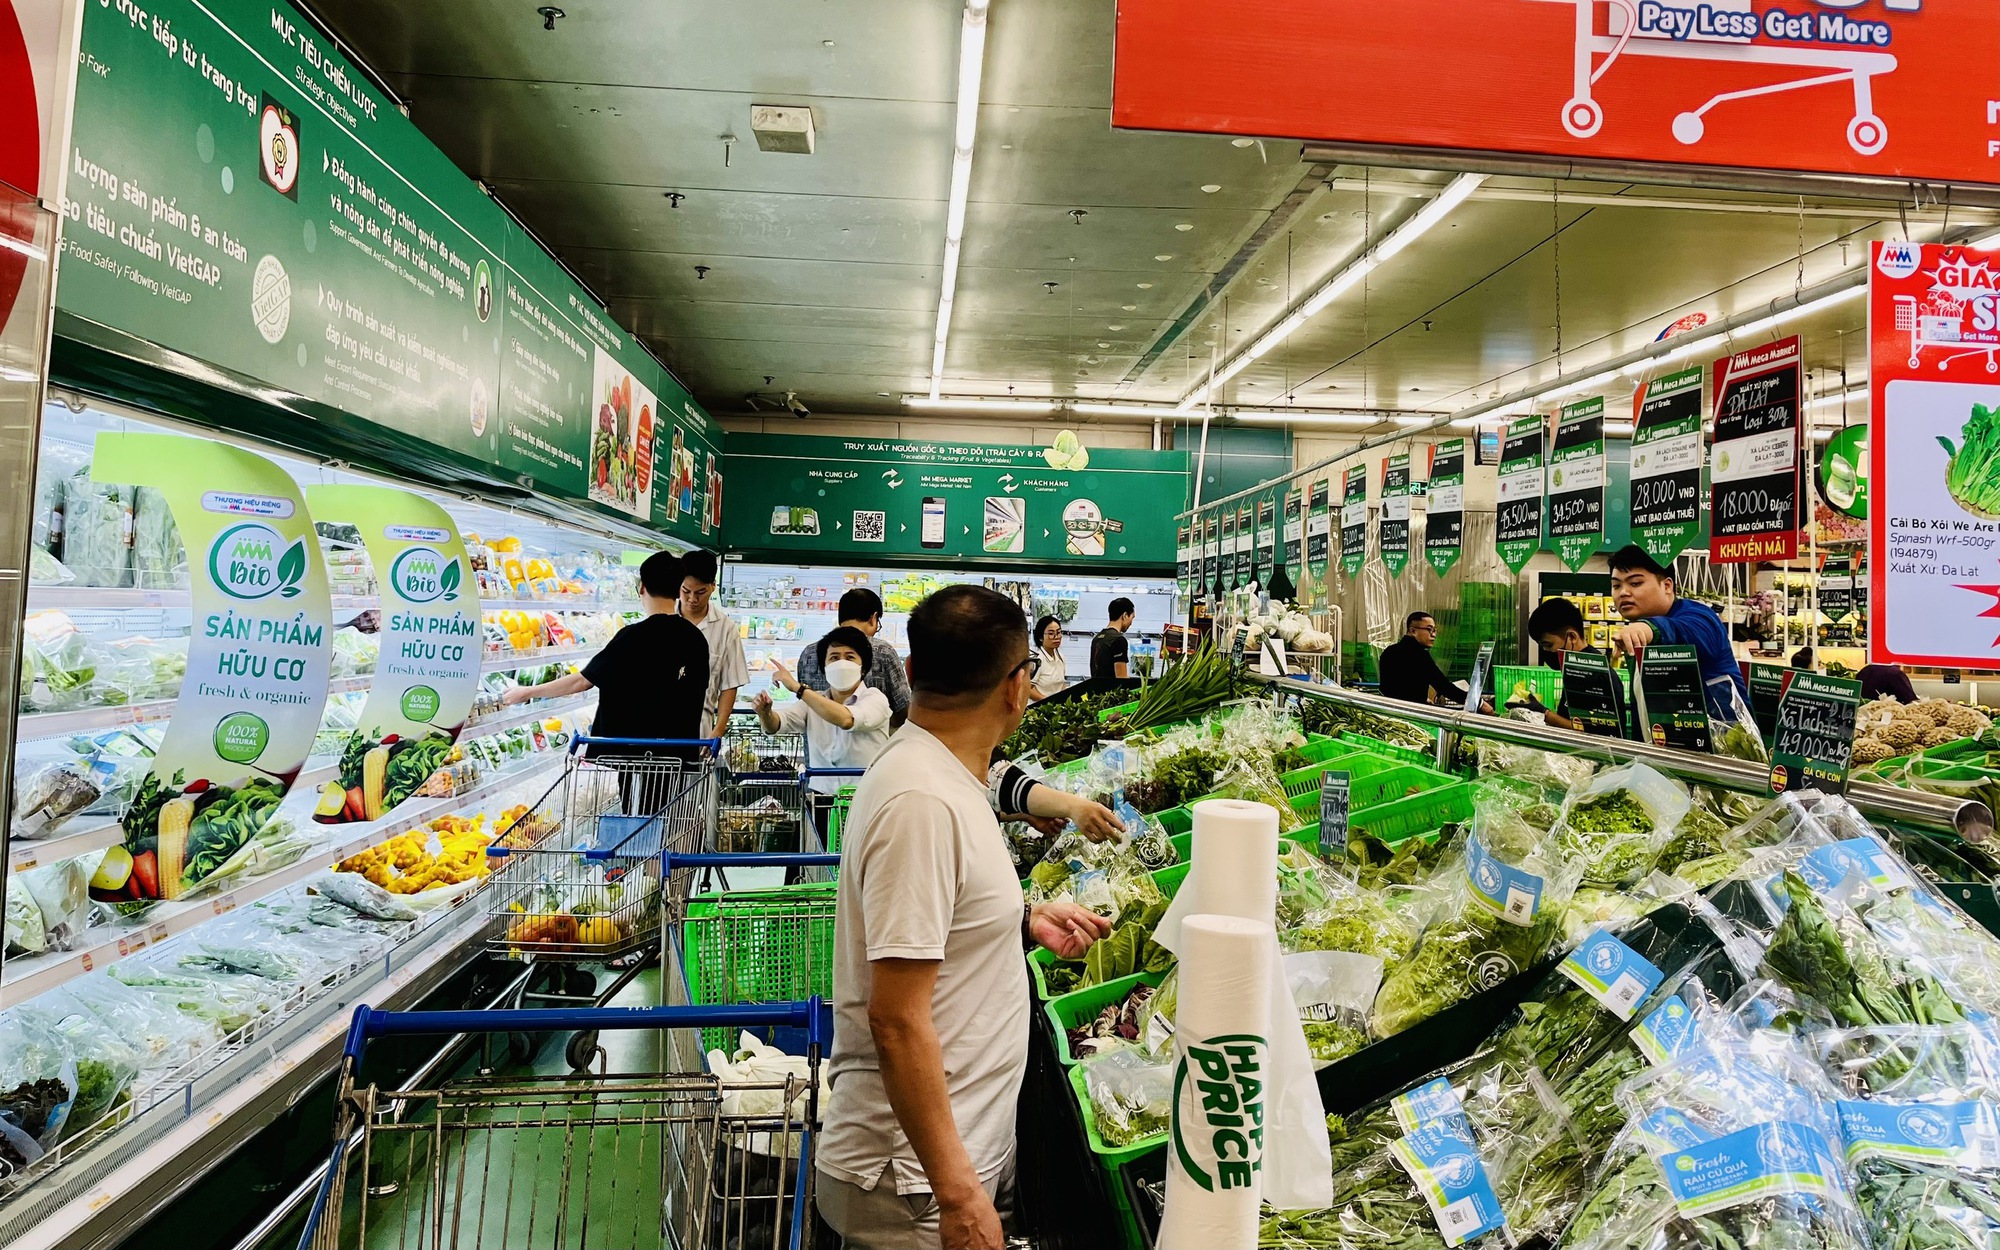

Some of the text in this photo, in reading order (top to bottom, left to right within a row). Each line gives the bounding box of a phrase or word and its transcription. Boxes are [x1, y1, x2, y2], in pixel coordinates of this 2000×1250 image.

[1642, 4, 1889, 44] Pay Less Get More
[152, 14, 178, 58] tiếp
[182, 38, 198, 69] từ
[200, 52, 234, 103] trang
[236, 81, 257, 117] trại
[271, 8, 377, 122] MỤC TIÊU CHIẾN LƯỢC
[295, 65, 357, 128] Strategic Objectives
[74, 147, 248, 264] lượng sản phẩm & an toàn
[329, 220, 348, 242] Support
[330, 194, 342, 214] và
[344, 202, 365, 234] nông
[366, 216, 381, 241] dân
[393, 238, 410, 261] phát
[86, 202, 116, 239] tiêu
[120, 223, 162, 262] chuẩn
[166, 242, 223, 291] VietGAP.
[69, 240, 192, 304] Food Safety Following VietGAP
[1937, 263, 1994, 290] GIÁ
[326, 290, 343, 319] Quy
[1972, 295, 2000, 332] S
[1963, 332, 1998, 342] Get More
[844, 442, 865, 450] TRUY
[867, 441, 890, 452] XUẤT
[920, 444, 936, 454] GỐC
[948, 447, 968, 456] THEO
[985, 447, 1006, 458] (TRÁI
[1008, 448, 1026, 458] CÂY
[844, 470, 858, 479] CẤP
[1632, 480, 1676, 511] 28.000
[1678, 486, 1695, 499] VNĐ
[1720, 489, 1768, 519] 18.000
[1634, 514, 1648, 524] +VAT
[1648, 512, 1662, 524] (BAO
[1722, 524, 1736, 534] +VAT
[1736, 522, 1750, 532] (BAO
[1890, 517, 1908, 528] Cải
[1930, 520, 1948, 530] Xôi
[1952, 520, 1970, 531] We
[1974, 522, 1994, 532] Are
[1720, 534, 1786, 558] KHUYẾN MÃI
[1890, 532, 1996, 550] Spinash Wrf-500gr
[1890, 548, 1938, 560] (194879)
[230, 560, 270, 587] Bio
[1890, 562, 1916, 574] Xuất
[406, 574, 436, 593] Bio
[205, 610, 323, 647] SẢN PHẨM
[390, 610, 475, 636] SẢN PHẨM
[401, 639, 464, 662] HỮU CƠ
[218, 648, 306, 682] HỮU CƠ
[388, 663, 470, 680] fresh & organic
[198, 682, 311, 706] fresh & organic
[410, 694, 433, 704] 100%
[408, 702, 432, 710] NATURAL
[227, 724, 260, 739] 100%
[1674, 718, 1683, 728] GIÁ
[1684, 718, 1692, 728] CHỈ
[224, 736, 258, 746] NATURAL
[224, 744, 257, 753] PRODUCT
[1779, 730, 1830, 757] 49.000
[1803, 765, 1842, 783] GIÁ CHỈ CÒN
[1187, 1044, 1252, 1191] PRICE
[1683, 1159, 1749, 1188] RAU CỦ QUẢ
[1692, 1152, 1731, 1173] Fresh
[1688, 1181, 1707, 1192] FRUIT
[1713, 1170, 1749, 1185] VEGETABLE
